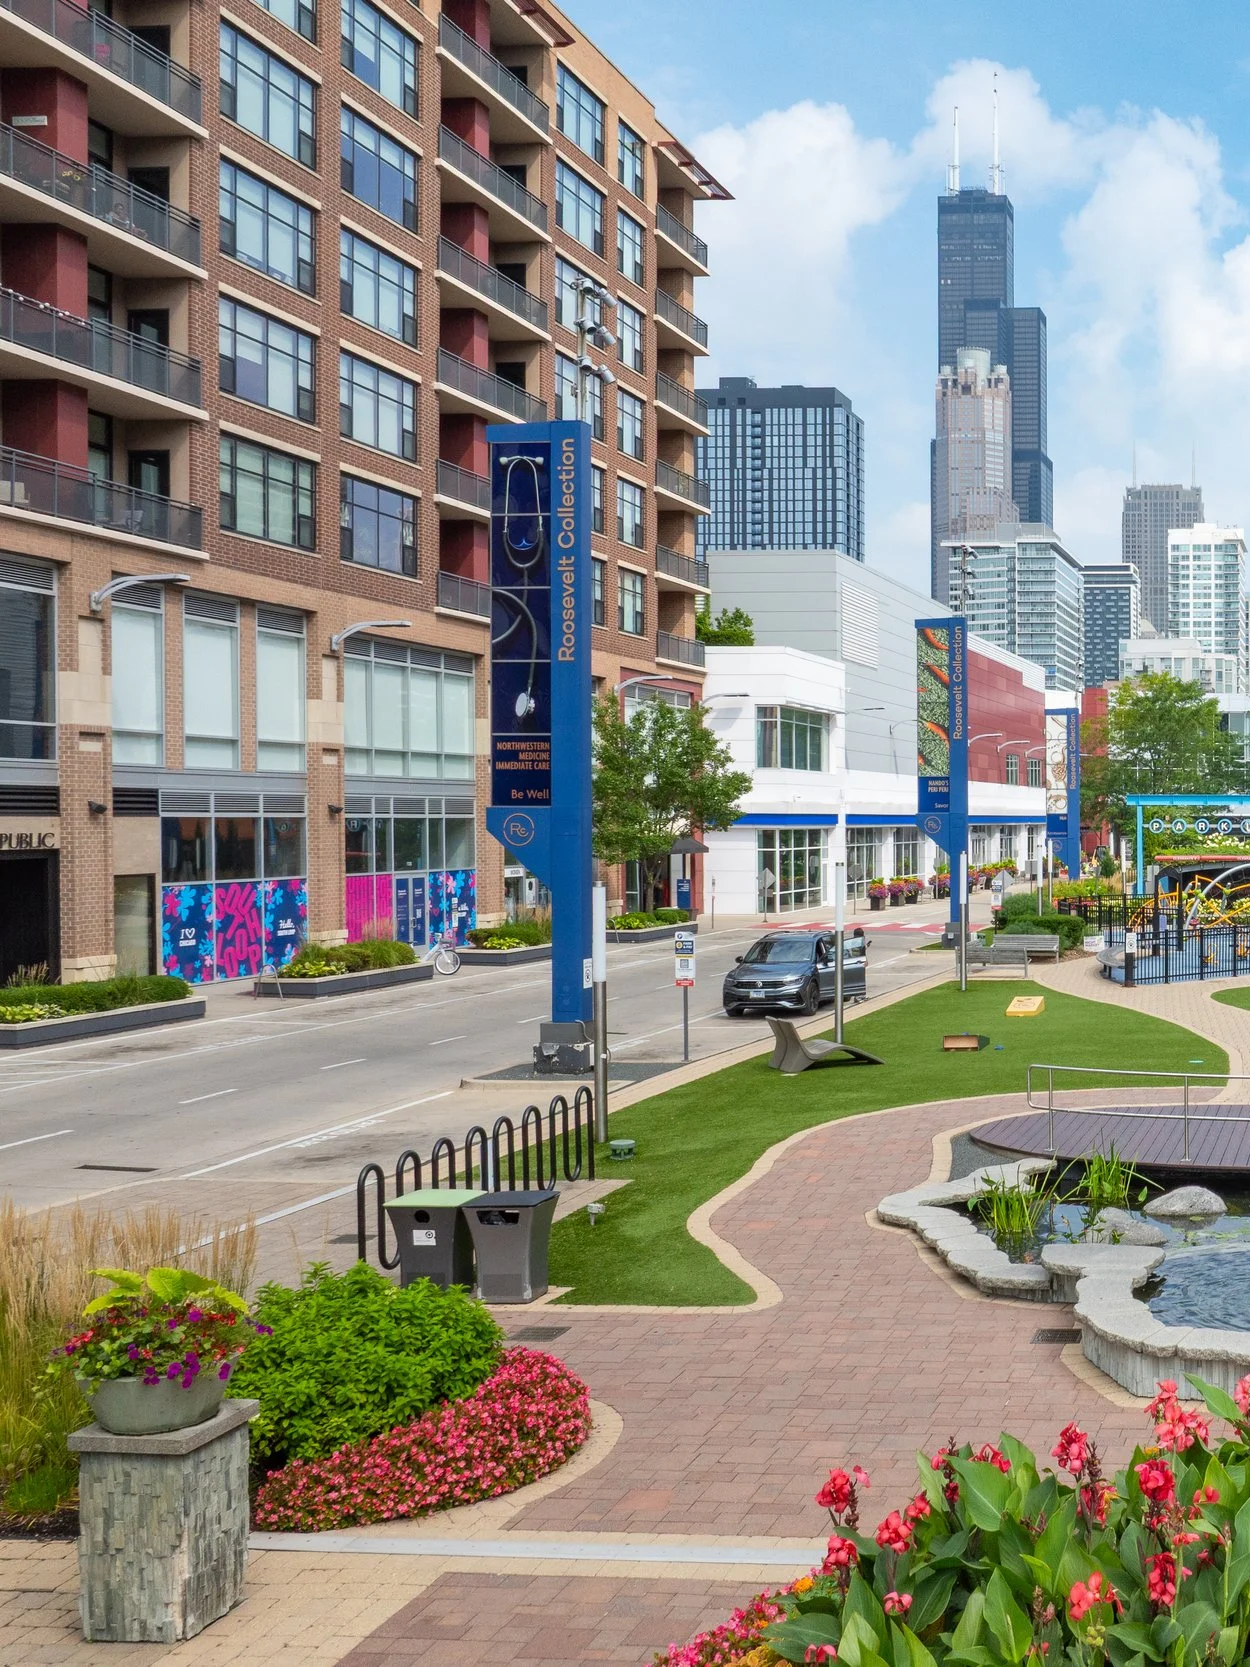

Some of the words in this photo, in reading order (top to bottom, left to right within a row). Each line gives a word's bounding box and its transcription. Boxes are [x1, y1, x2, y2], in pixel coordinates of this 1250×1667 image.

[557, 438, 575, 549] Collection
[558, 555, 575, 661] Roosevelt
[953, 626, 962, 682] Collection
[953, 685, 962, 740] Roosevelt
[497, 742, 550, 750] NORTHWESTERN
[519, 751, 550, 760] MEDICINE
[496, 761, 533, 770] IMMEDIATE
[534, 761, 550, 770] CARE
[511, 789, 524, 799] Be
[526, 789, 550, 799] Well
